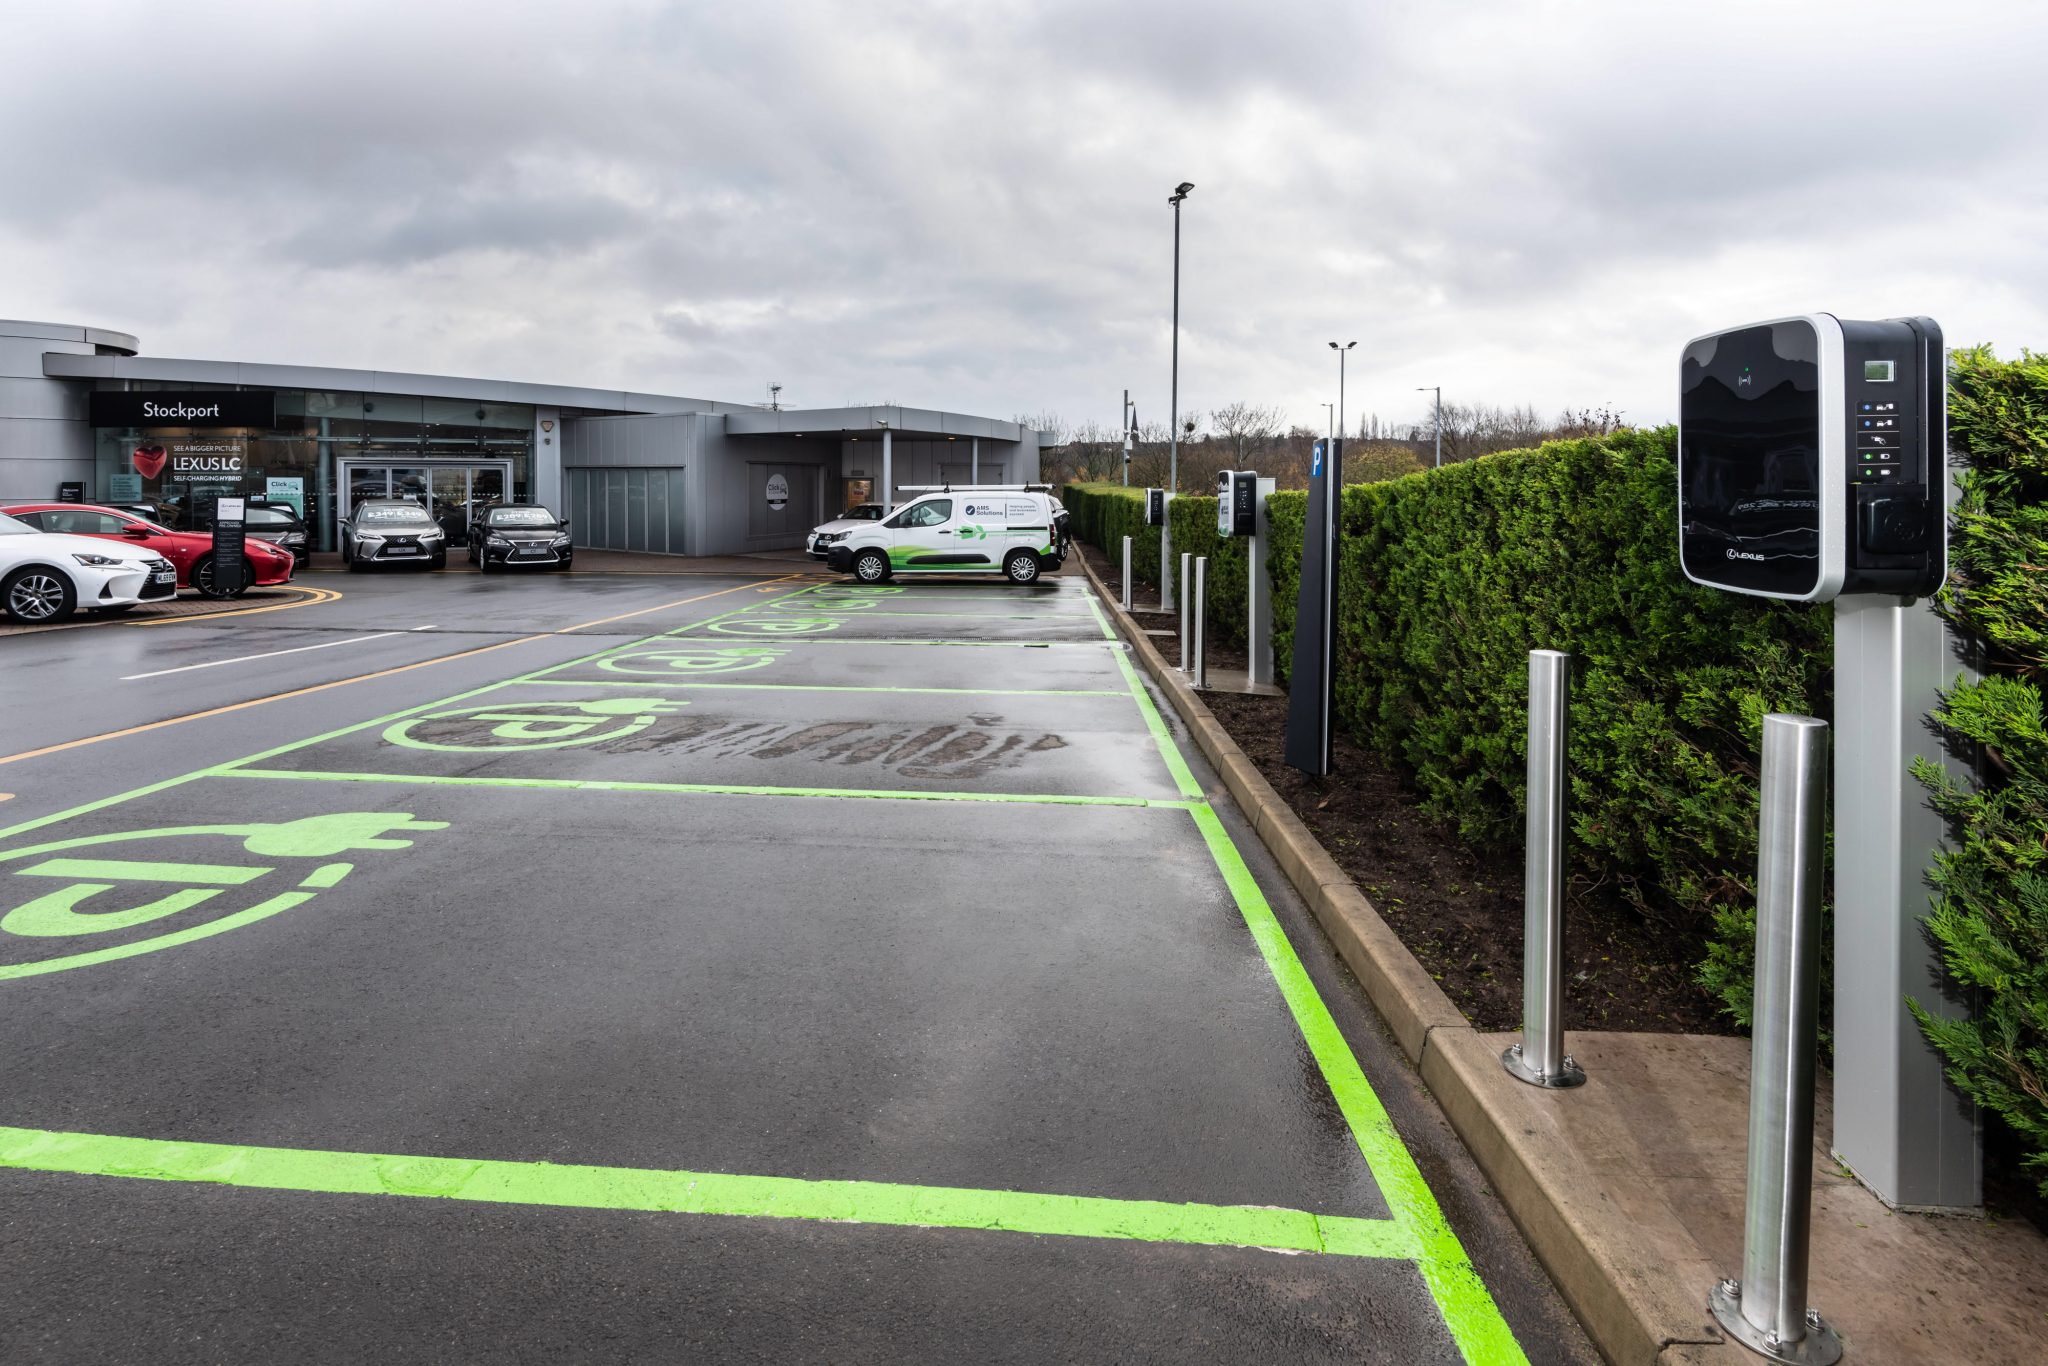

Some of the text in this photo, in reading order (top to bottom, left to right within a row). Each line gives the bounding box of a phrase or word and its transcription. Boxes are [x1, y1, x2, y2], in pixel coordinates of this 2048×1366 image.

[143, 401, 220, 420] Stockport
[173, 457, 241, 471] LEXUS LC
[1312, 446, 1321, 476] P
[1736, 551, 1765, 562] LEXUS
